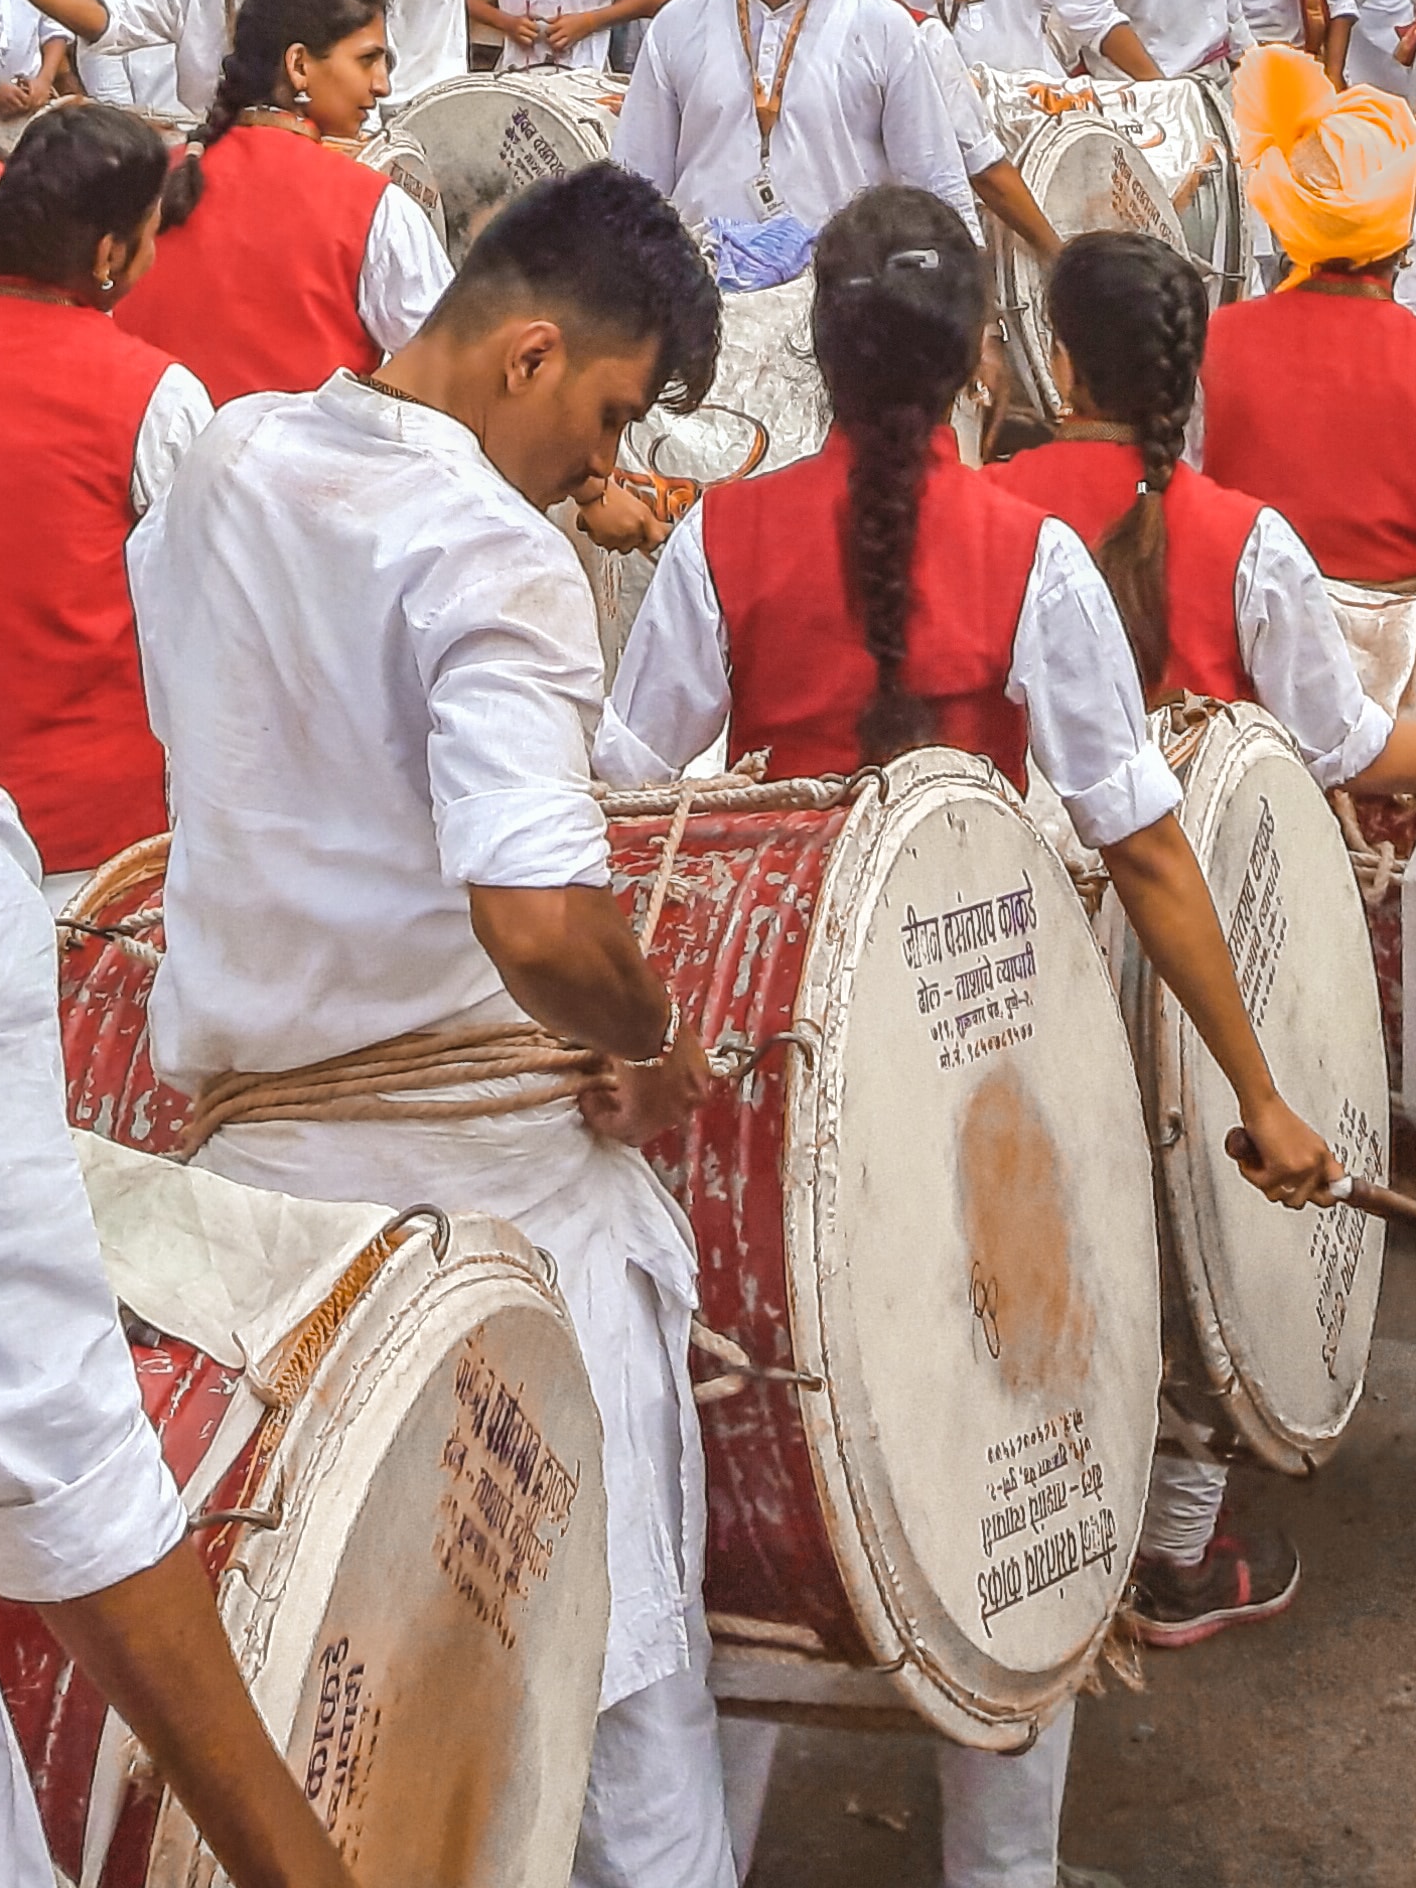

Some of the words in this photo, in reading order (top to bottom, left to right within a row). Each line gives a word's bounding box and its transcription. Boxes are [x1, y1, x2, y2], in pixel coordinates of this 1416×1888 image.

[942, 891, 998, 957] वसंतराव
[995, 869, 1038, 939] काकडे
[955, 954, 994, 1001] ताशांचे
[977, 1555, 1025, 1638] काकडे
[1024, 1527, 1079, 1600] वसंतराव
